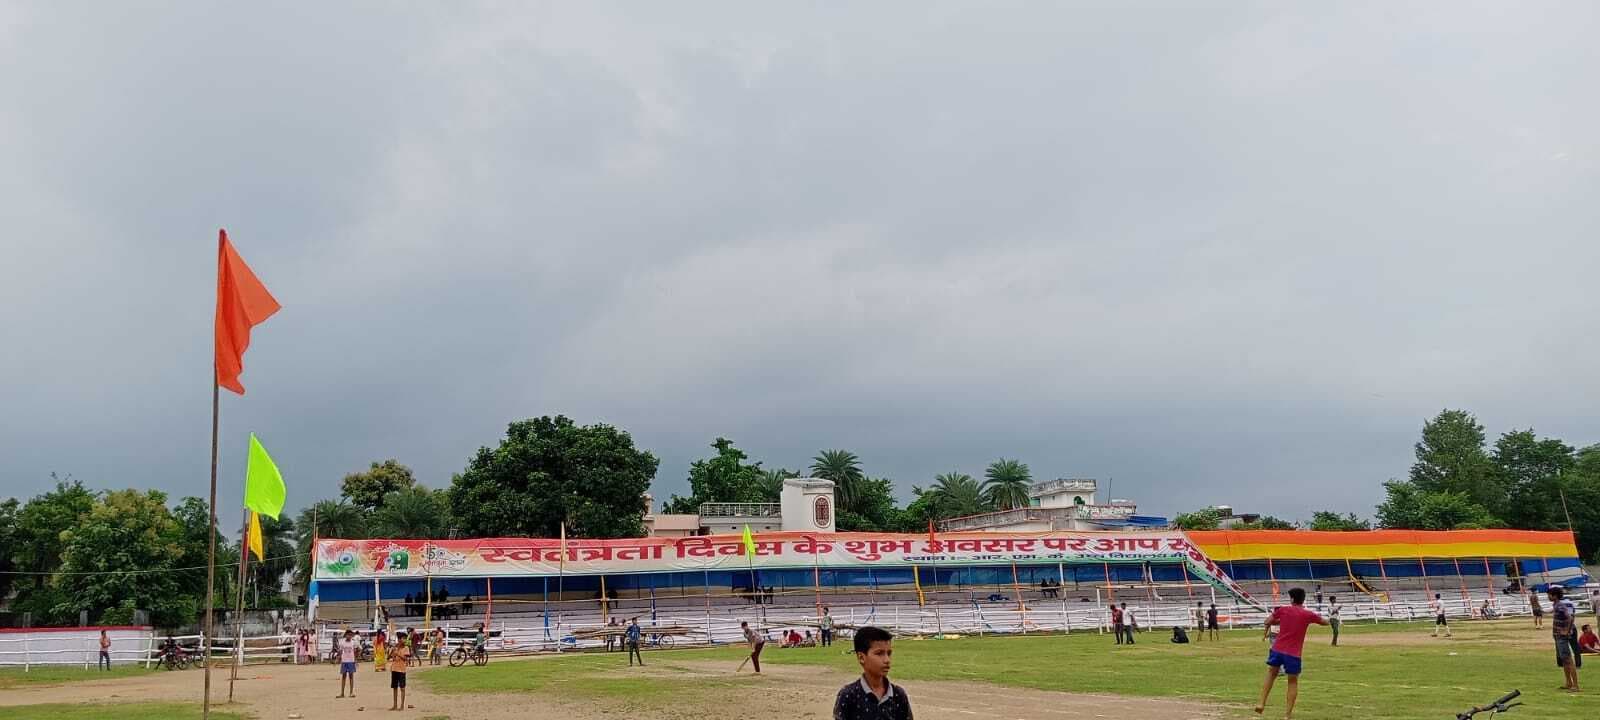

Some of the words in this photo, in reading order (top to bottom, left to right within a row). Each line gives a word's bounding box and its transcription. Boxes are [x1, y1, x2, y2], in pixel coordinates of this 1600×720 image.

[478, 541, 666, 563] स्वतंत्रता
[673, 537, 786, 558] दिवस
[792, 535, 836, 555] के
[844, 540, 914, 561] शुभ
[922, 538, 1039, 554] अवसर
[1043, 538, 1088, 551] पर
[1094, 538, 1162, 551] आप
